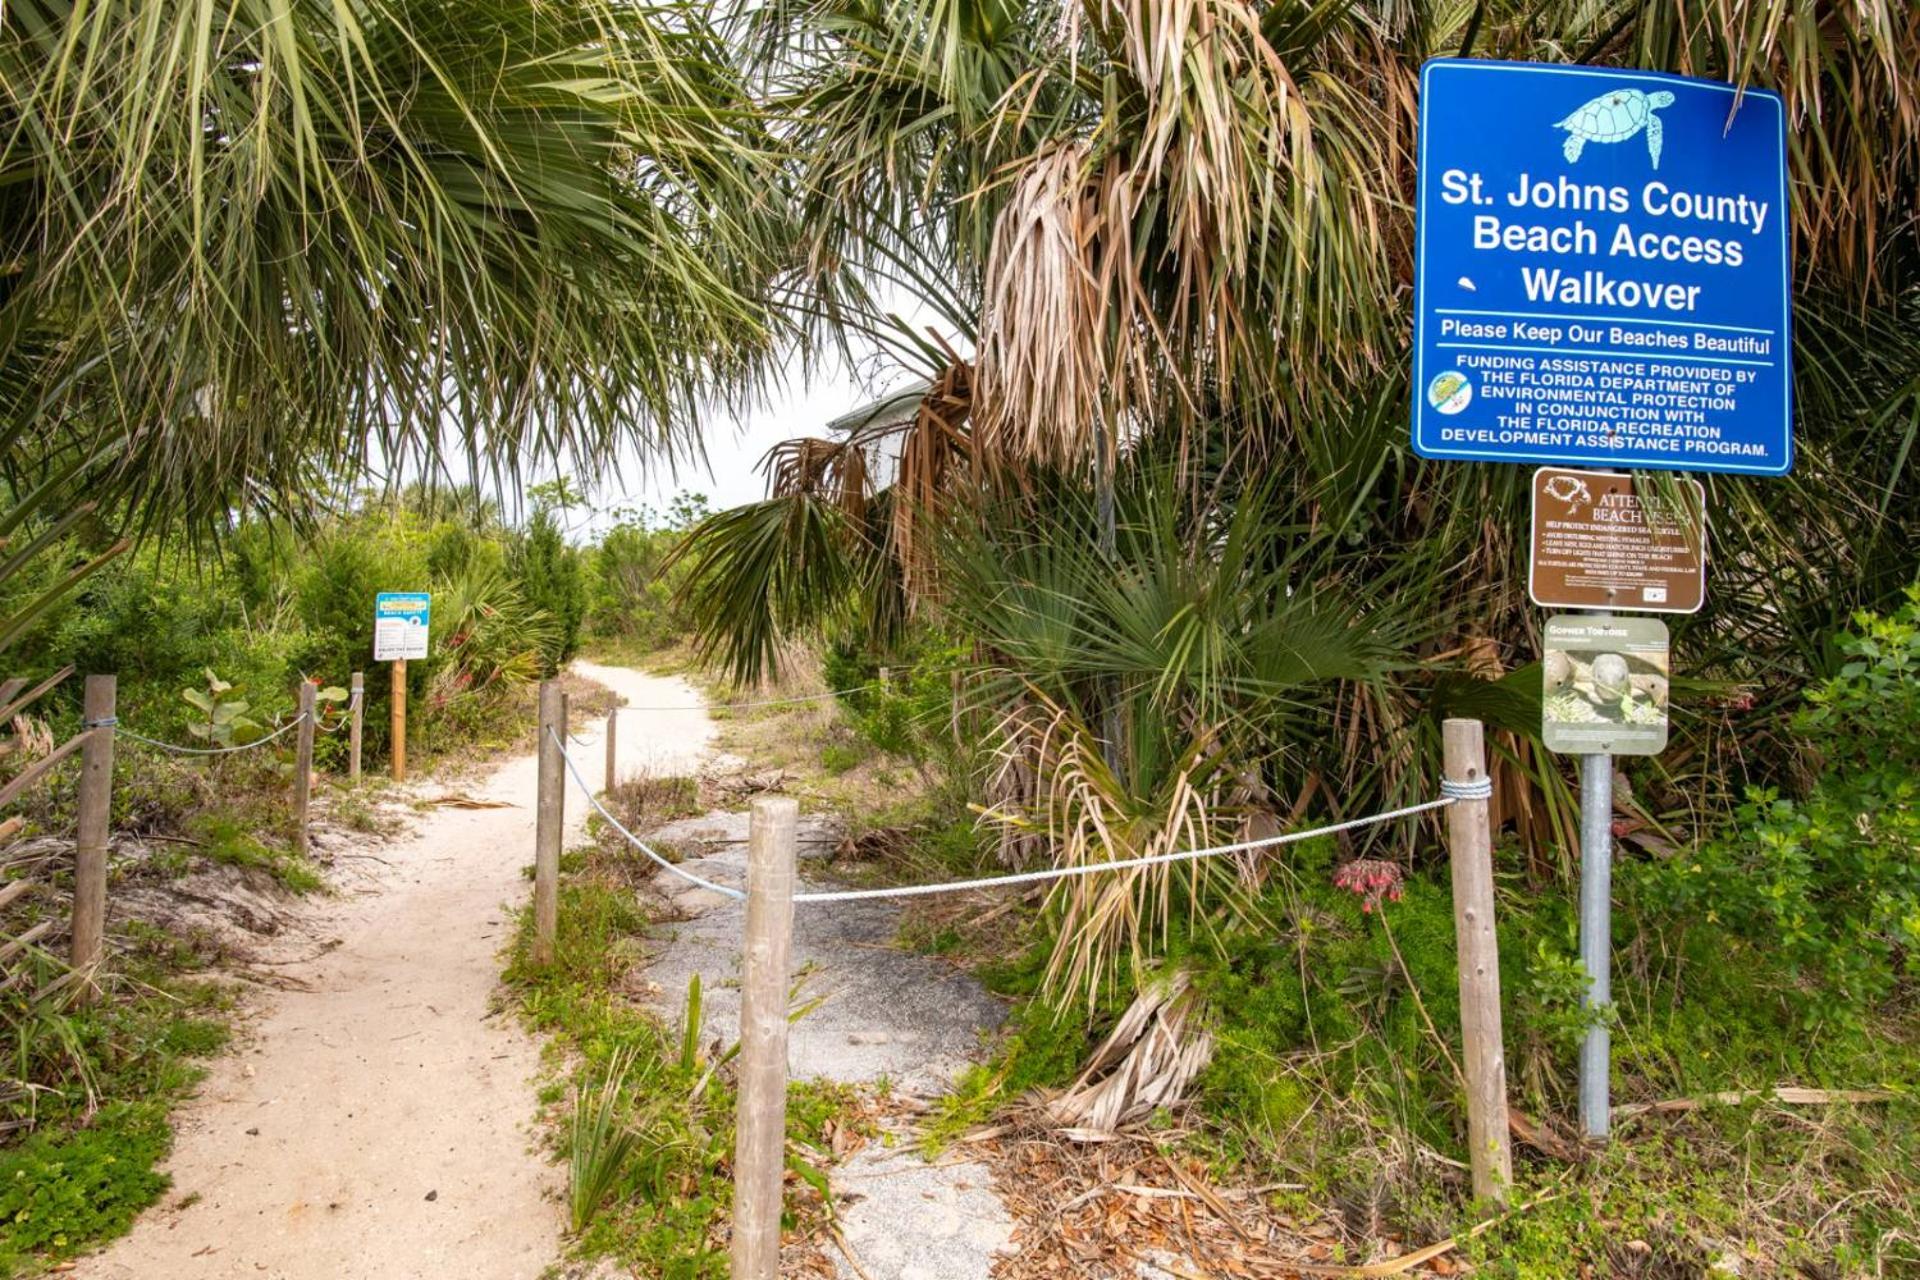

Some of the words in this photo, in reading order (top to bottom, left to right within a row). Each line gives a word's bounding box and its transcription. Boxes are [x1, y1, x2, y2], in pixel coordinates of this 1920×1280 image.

[1441, 169, 1493, 205] St.
[1507, 174, 1629, 213] Johns
[1642, 181, 1768, 234] County
[1474, 215, 1597, 255] Beach
[1609, 223, 1743, 267] Access
[1521, 267, 1701, 311] Walkover
[1441, 319, 1507, 339] Please
[1513, 322, 1562, 345] Keep
[1569, 325, 1603, 343] Our
[1610, 328, 1688, 349] Beaches
[1694, 333, 1770, 355] Beautiful
[1456, 355, 1534, 370] FUNDING
[1539, 360, 1645, 376] ASSISTANCE
[1650, 364, 1731, 381] PROVIDED
[1736, 371, 1757, 383] BY
[1481, 371, 1515, 384] THE
[1520, 373, 1594, 388] FLORIDA
[1600, 377, 1710, 394] DEPARTMENT
[1715, 384, 1736, 396] OF
[1481, 387, 1627, 404] ENVIRONMENTAL
[1632, 393, 1736, 411] PROTECTION
[1515, 402, 1532, 414] IN
[1537, 404, 1659, 420] CONJUNCTION
[1664, 409, 1705, 423] WITH
[1498, 416, 1531, 429] THE
[1536, 418, 1610, 433] FLORIDA
[1616, 422, 1721, 439] RECREATION
[1441, 429, 1572, 445] DEVELOPMENT
[1575, 435, 1680, 452] ASSISTANCE
[1685, 440, 1768, 457] PROGRAM.
[1546, 521, 1561, 529] HELP
[1562, 522, 1589, 531] PROTECT
[1590, 524, 1637, 533] ENDANGERED
[1593, 508, 1642, 524] BEACH
